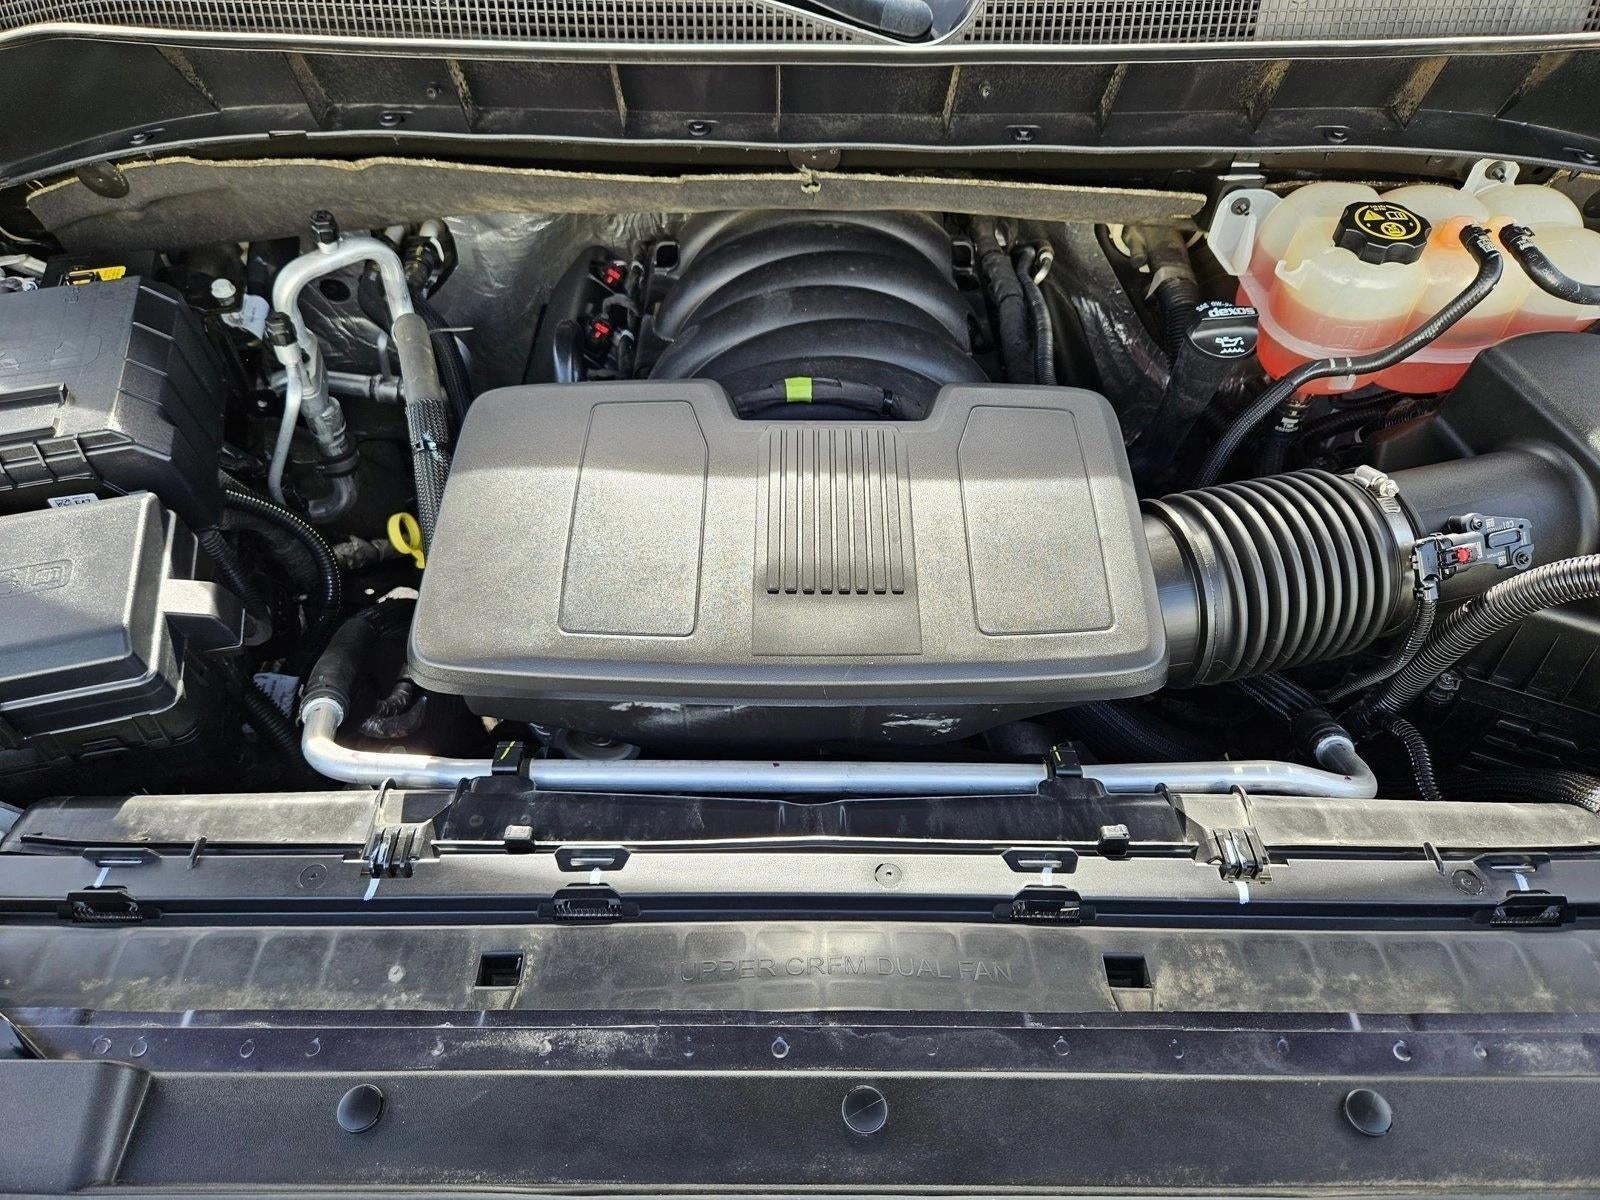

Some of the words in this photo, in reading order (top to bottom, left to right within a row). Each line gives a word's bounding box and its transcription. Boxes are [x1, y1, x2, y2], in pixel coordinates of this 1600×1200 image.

[1208, 307, 1256, 317] dexos
[680, 957, 776, 981] UPPER
[785, 956, 867, 976] CRFM
[877, 956, 952, 979] DUAL
[958, 959, 1013, 983] FAN
